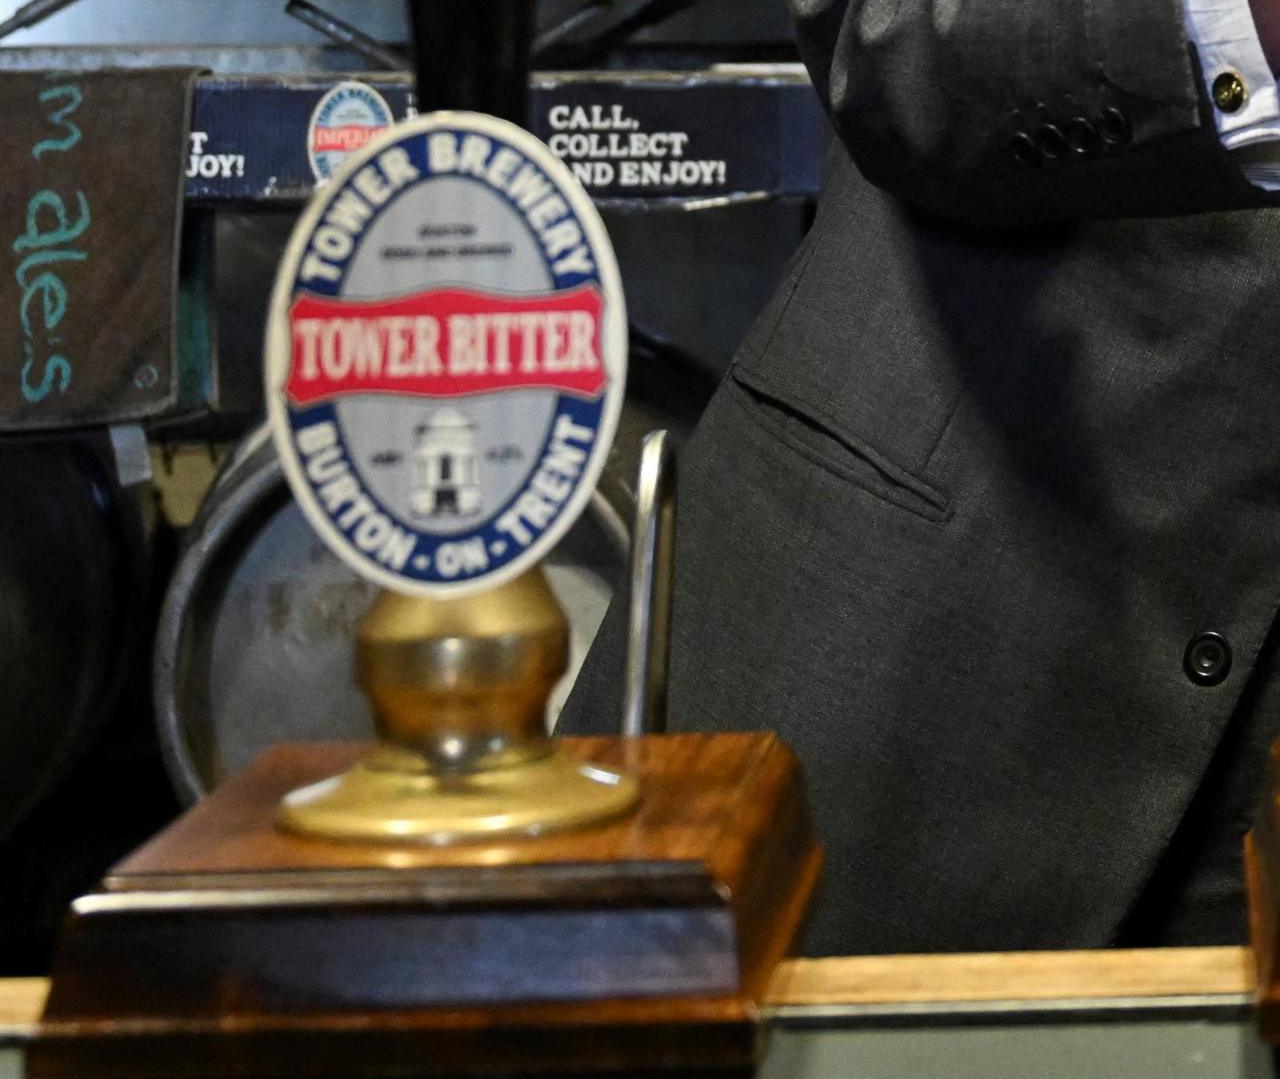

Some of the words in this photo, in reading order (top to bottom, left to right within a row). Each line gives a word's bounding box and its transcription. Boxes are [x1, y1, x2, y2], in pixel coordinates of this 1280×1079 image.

[549, 105, 640, 130] CALL,
[549, 133, 688, 158] COLLECT
[571, 161, 615, 186] ND
[619, 160, 727, 186] ENJOY!
[302, 146, 421, 283] TOWER
[427, 131, 596, 277] BREWERY
[297, 315, 443, 381] TOWER
[448, 310, 600, 376] BITTER
[299, 420, 418, 570] BURTON
[434, 541, 490, 578] ON
[496, 414, 596, 548] TRENT
